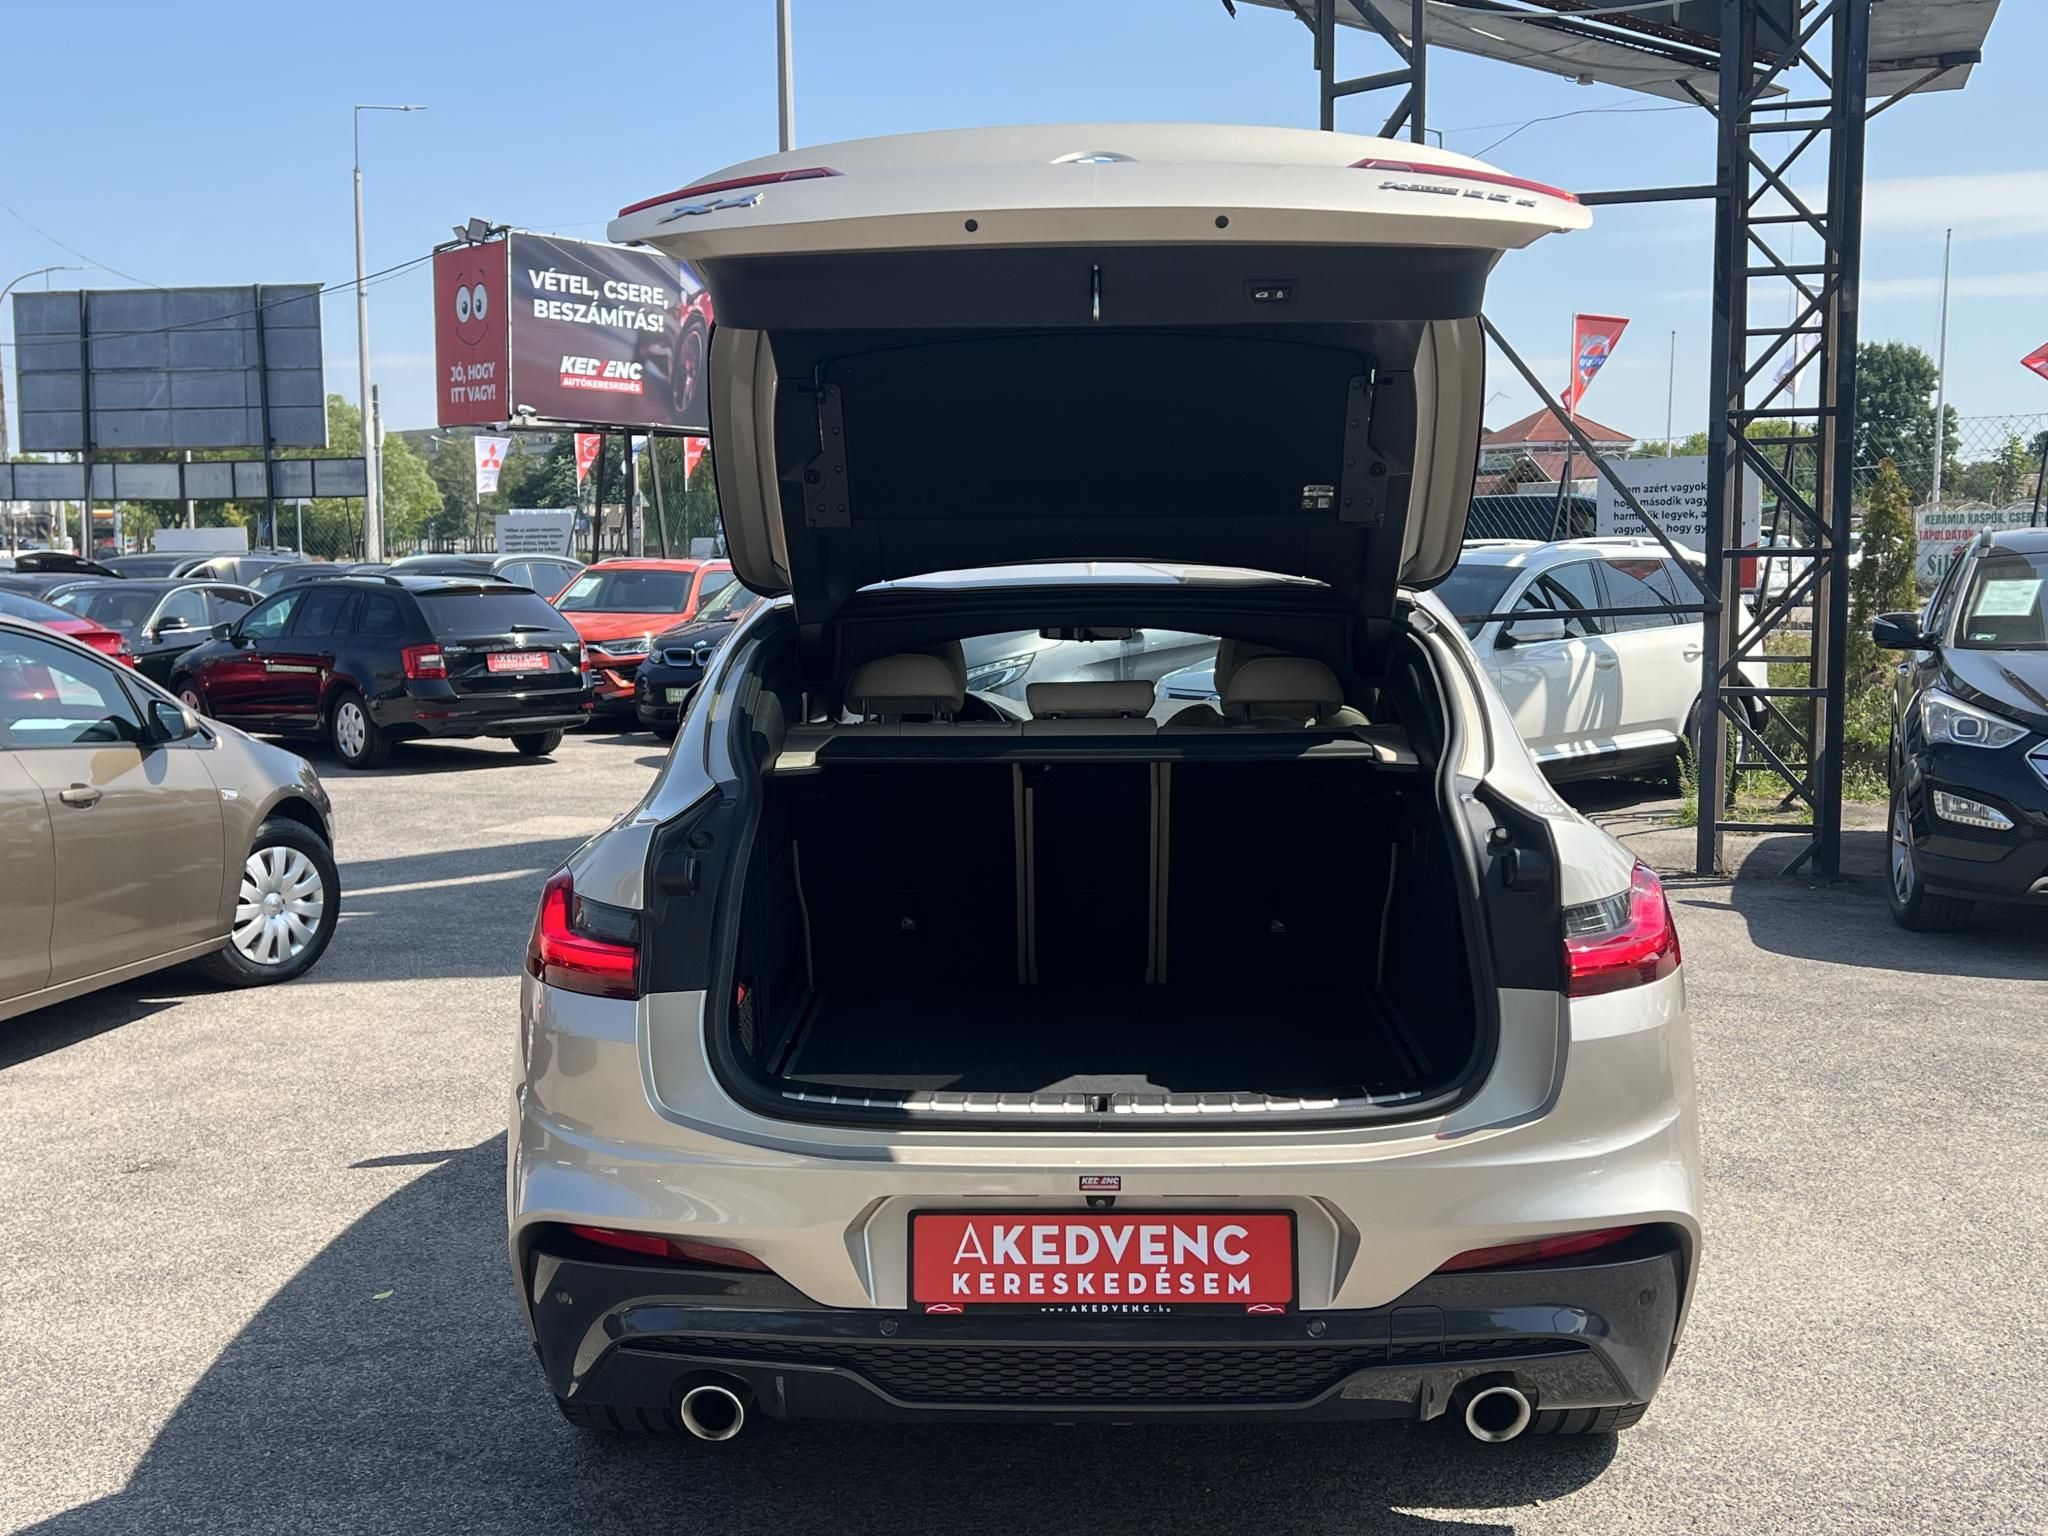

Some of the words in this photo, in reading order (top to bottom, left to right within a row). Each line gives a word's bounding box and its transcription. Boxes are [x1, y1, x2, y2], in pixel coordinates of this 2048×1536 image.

[528, 267, 599, 300] VÉTEL,
[603, 279, 669, 310] CSERE,
[533, 299, 664, 332] BESZÁMÍTÁS!
[450, 365, 467, 383] JÓ,
[467, 362, 496, 382] HOGY
[450, 387, 465, 402] ITT
[467, 384, 496, 402] VAGY!
[562, 376, 641, 394] AUTÓKERESKEDÉS
[1643, 483, 1668, 494] azért
[1641, 496, 1682, 507] második
[1661, 509, 1699, 522] legyek,
[1613, 524, 1647, 535] vagyok
[1666, 523, 1692, 535] hogy
[953, 1222, 1250, 1265] AKEDVENC
[952, 1266, 1250, 1295] KERESKEDÉSEM
[1041, 1304, 1171, 1313] www.AKEDVENC.hu
